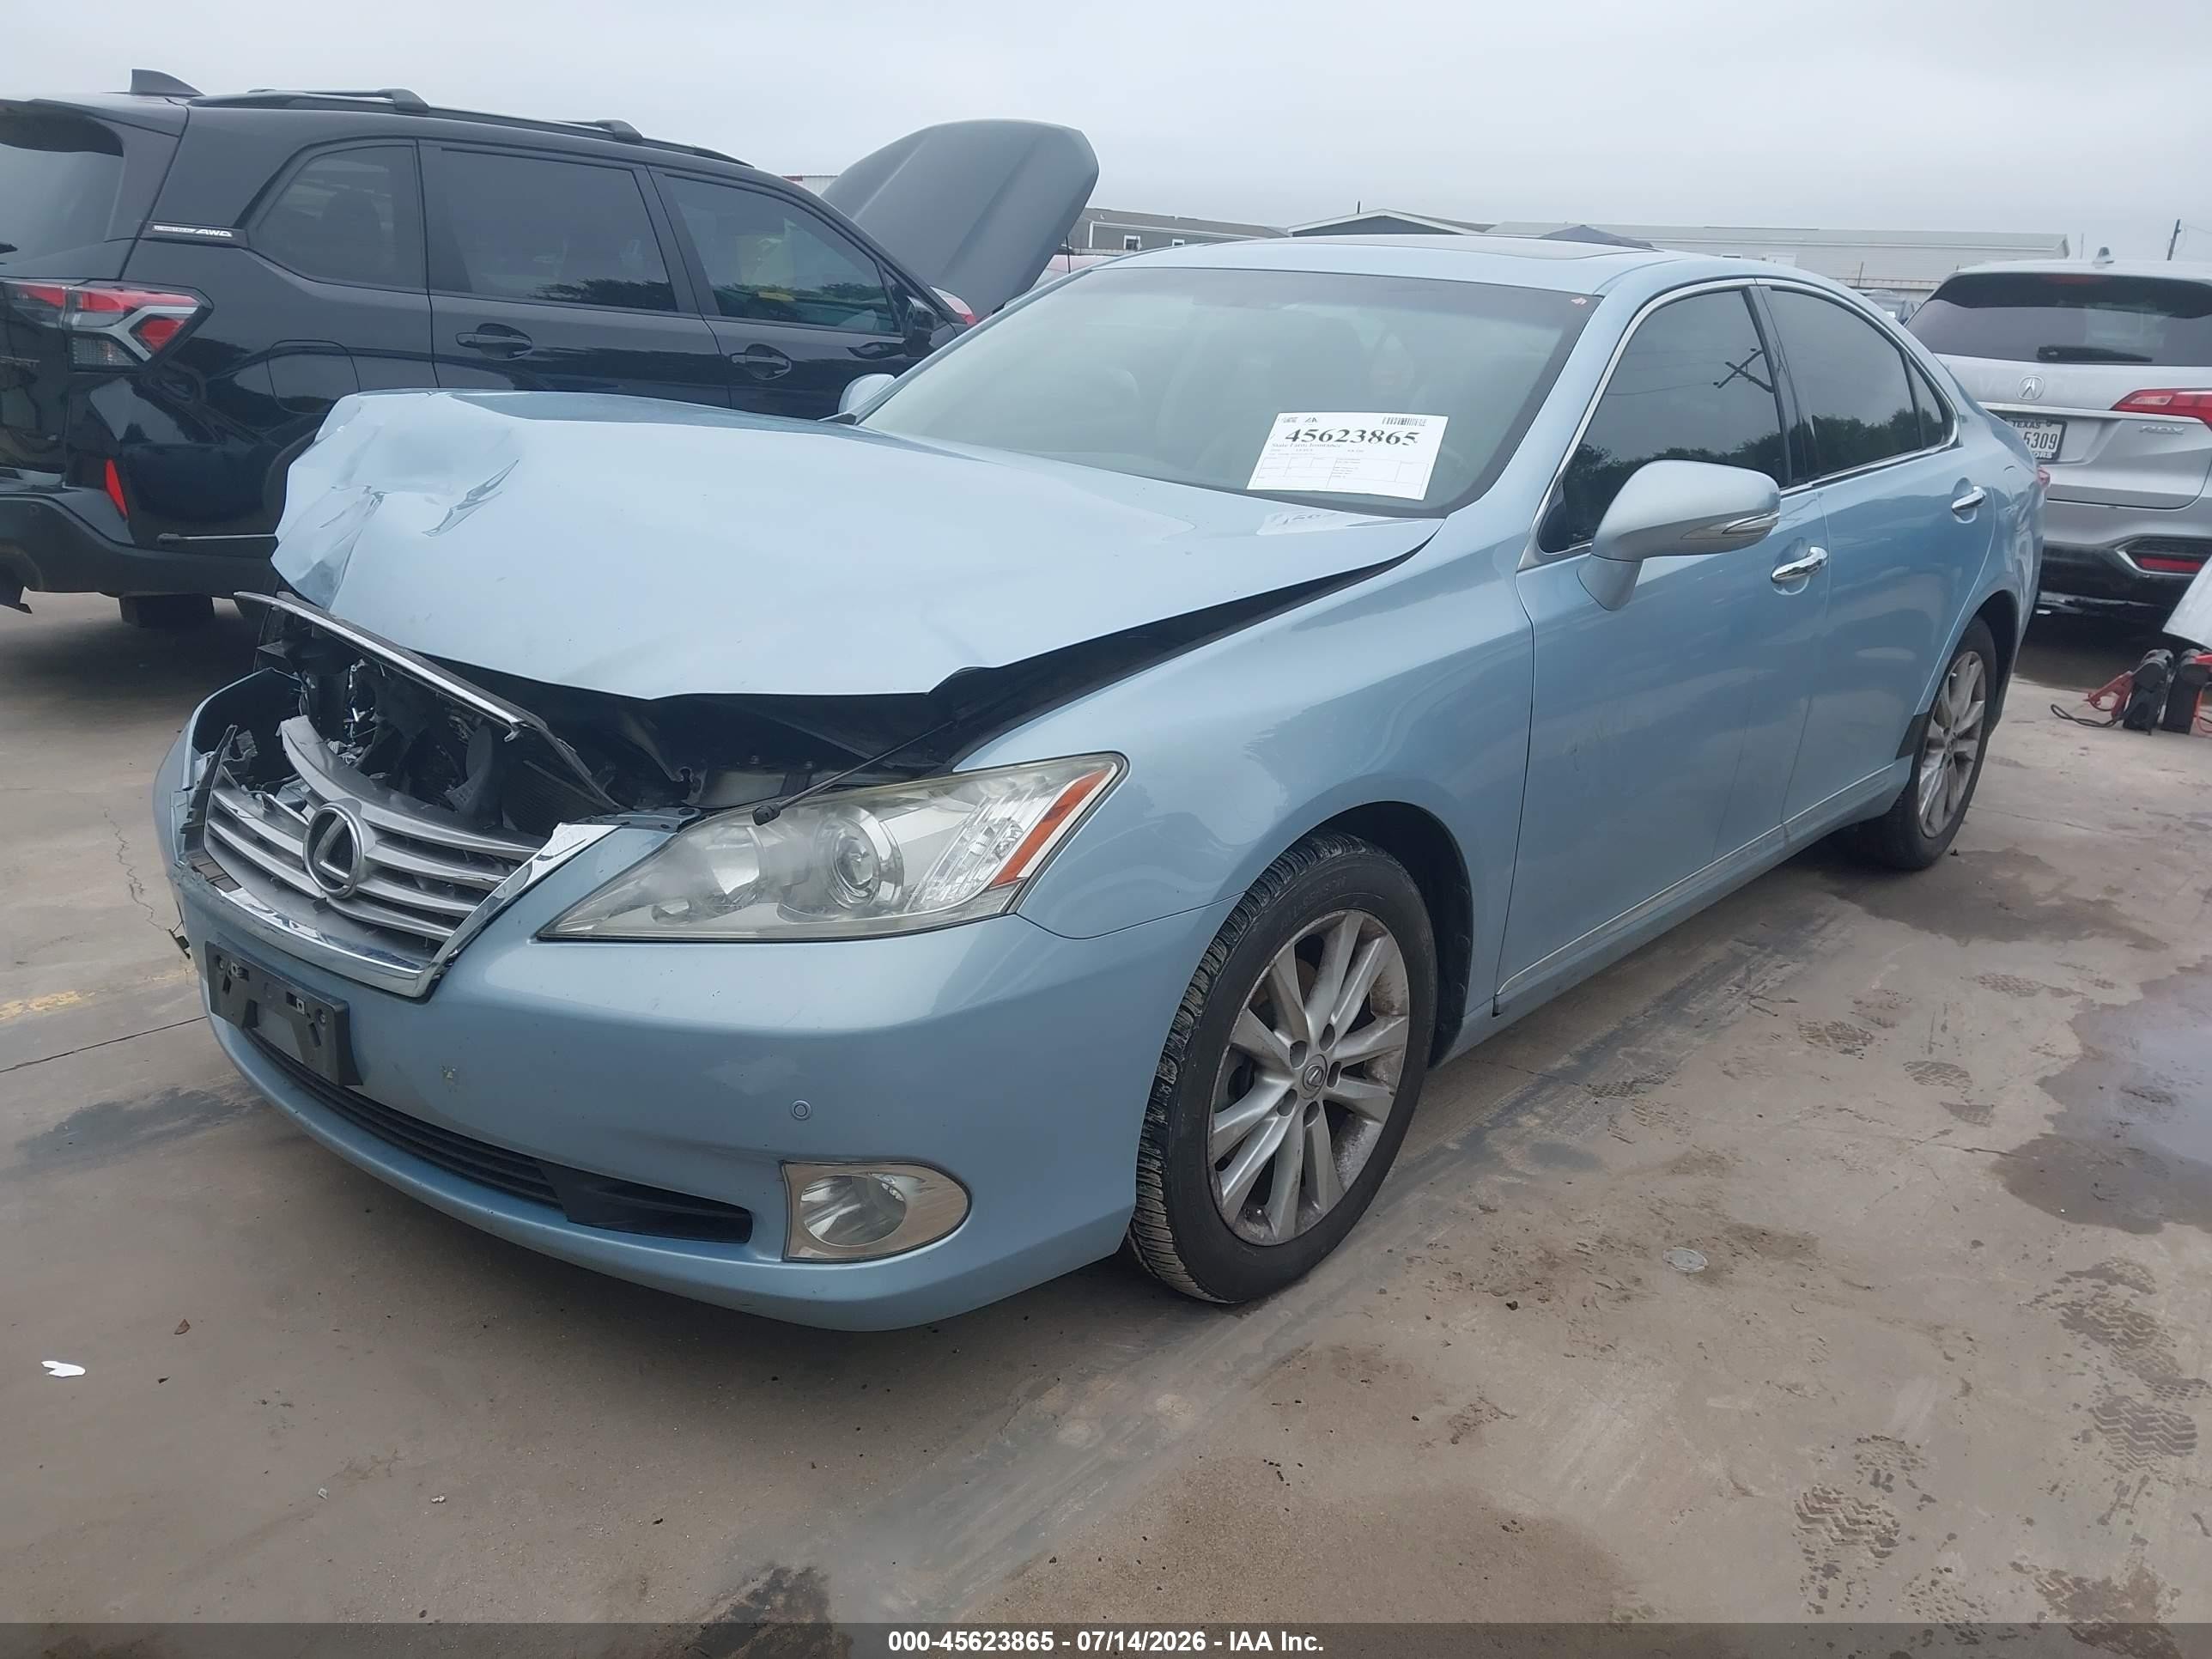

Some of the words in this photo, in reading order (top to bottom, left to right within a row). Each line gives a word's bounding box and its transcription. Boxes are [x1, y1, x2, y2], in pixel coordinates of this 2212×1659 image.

[195, 228, 233, 237] AWD
[2012, 419, 2041, 429] TEXAS
[1285, 428, 1420, 447] 45623865
